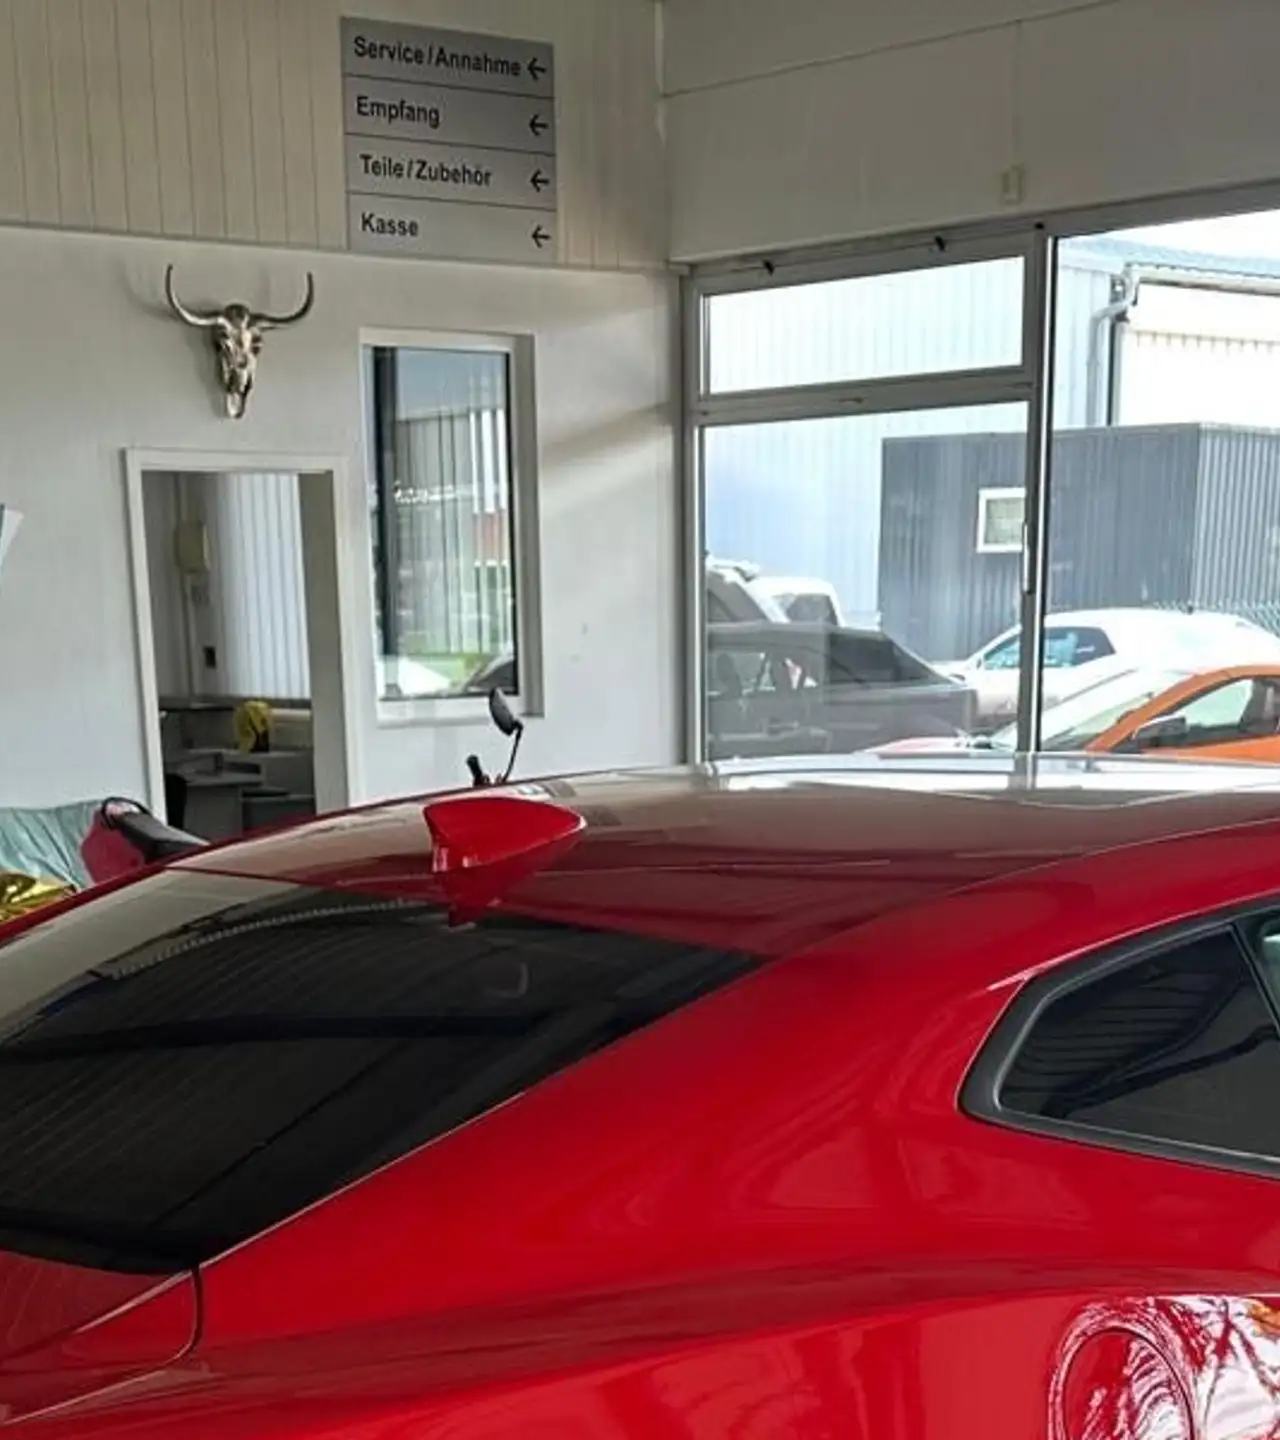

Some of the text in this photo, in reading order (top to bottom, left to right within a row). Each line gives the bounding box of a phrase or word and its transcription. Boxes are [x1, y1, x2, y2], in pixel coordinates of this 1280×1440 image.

[354, 36, 522, 76] Service/Annahme
[357, 95, 440, 129] Empfang
[361, 211, 419, 237] Kasse
